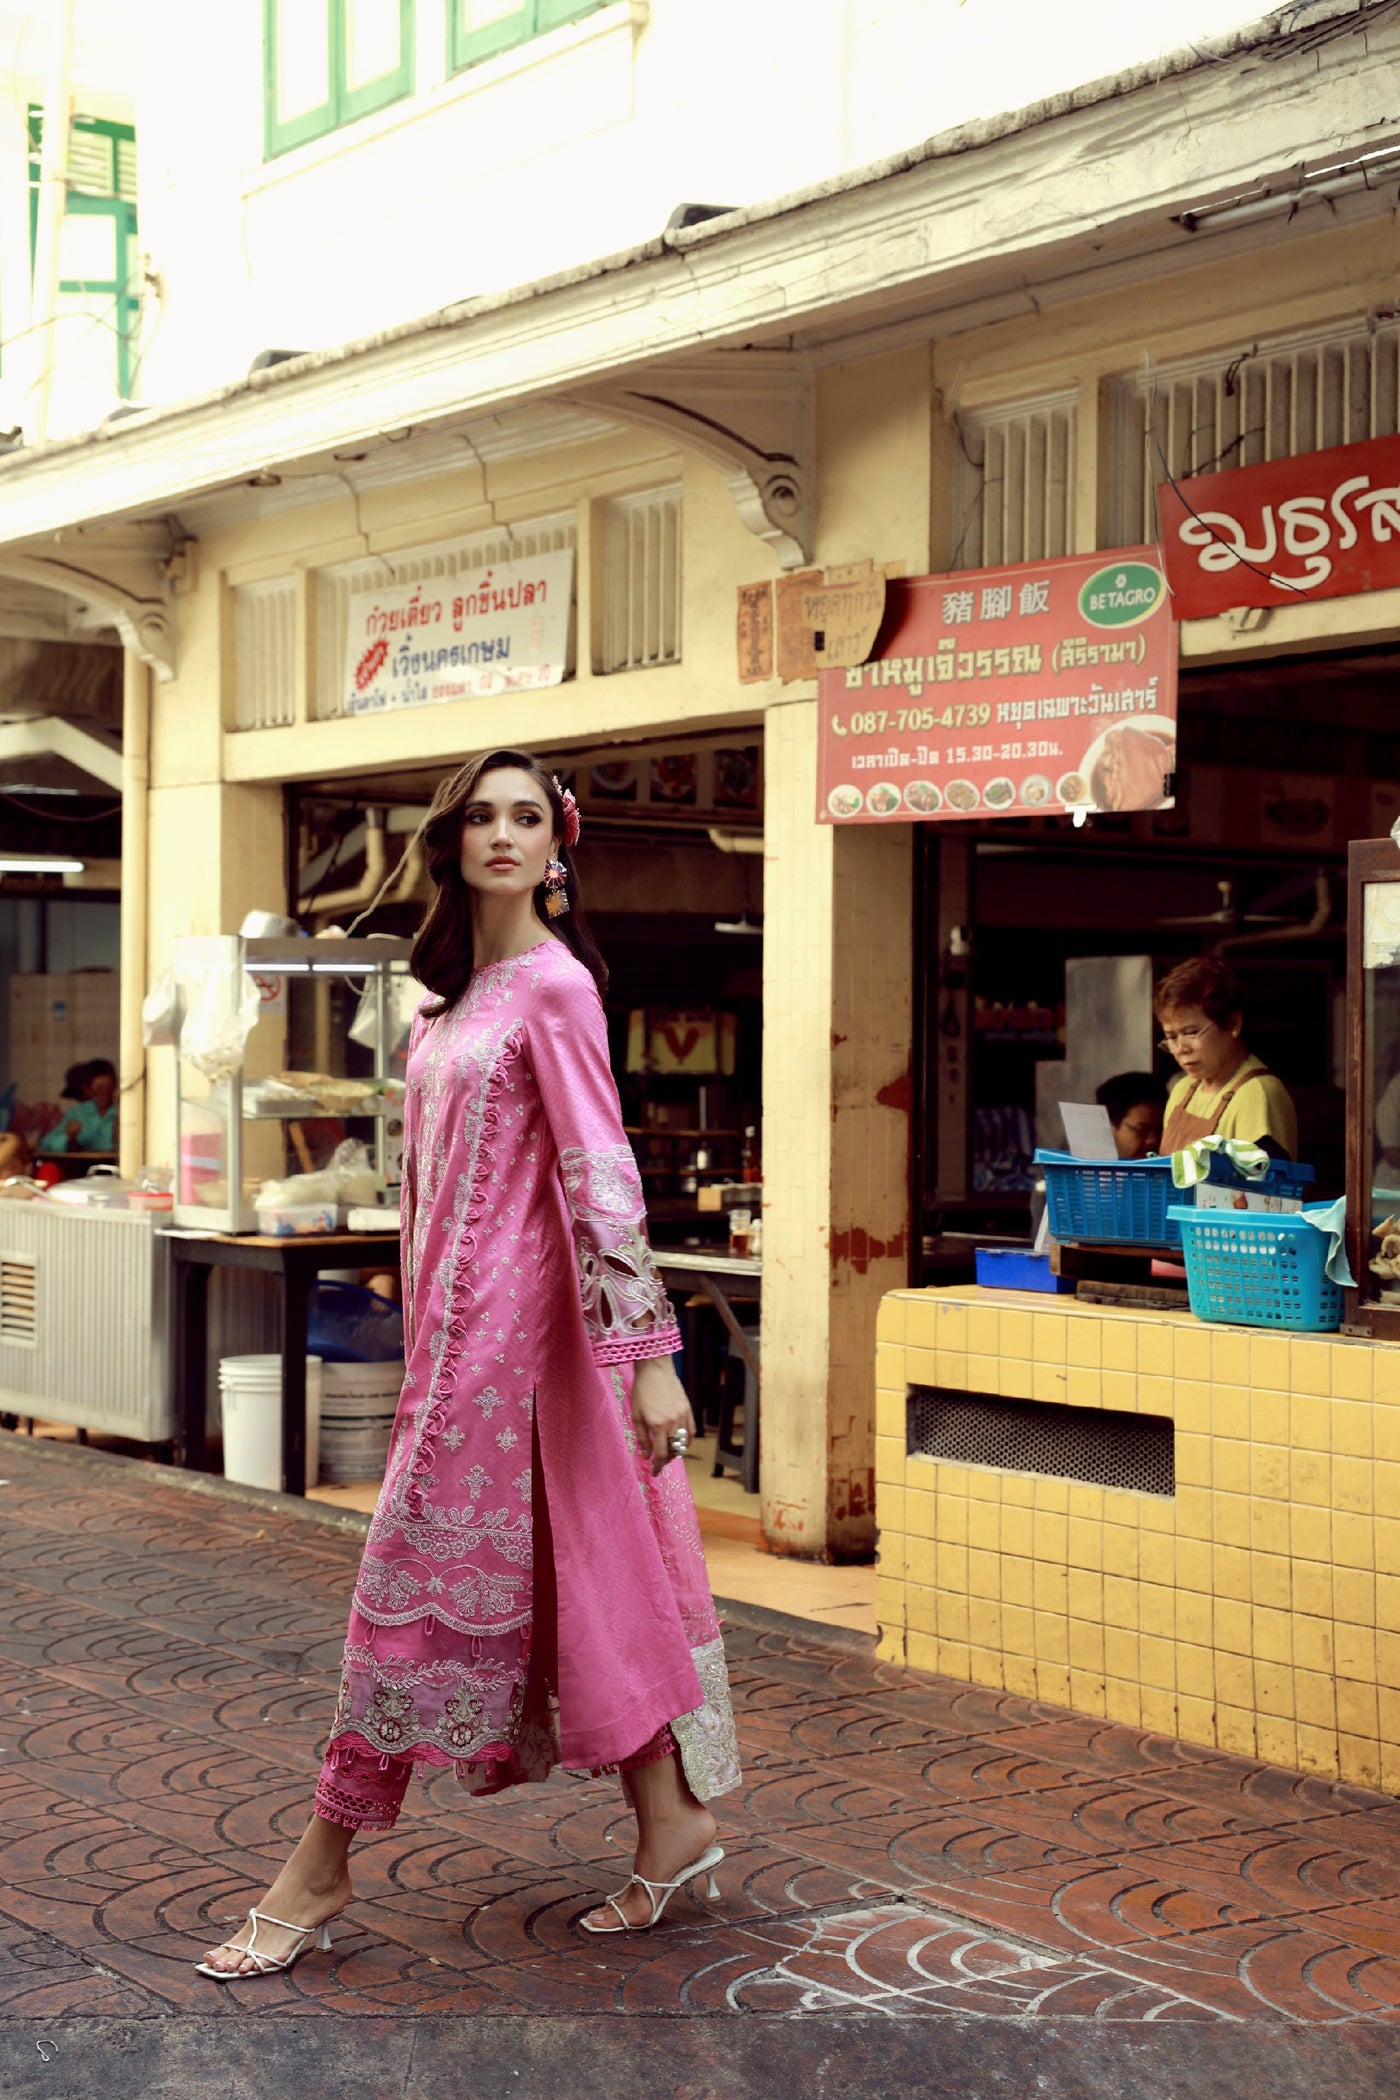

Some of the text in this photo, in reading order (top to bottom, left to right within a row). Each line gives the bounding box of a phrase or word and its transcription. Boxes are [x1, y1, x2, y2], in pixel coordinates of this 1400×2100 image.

[942, 579, 1051, 625] 豬腳飯
[1090, 586, 1156, 611] BETAGRO
[851, 702, 992, 735] 087-705-4739
